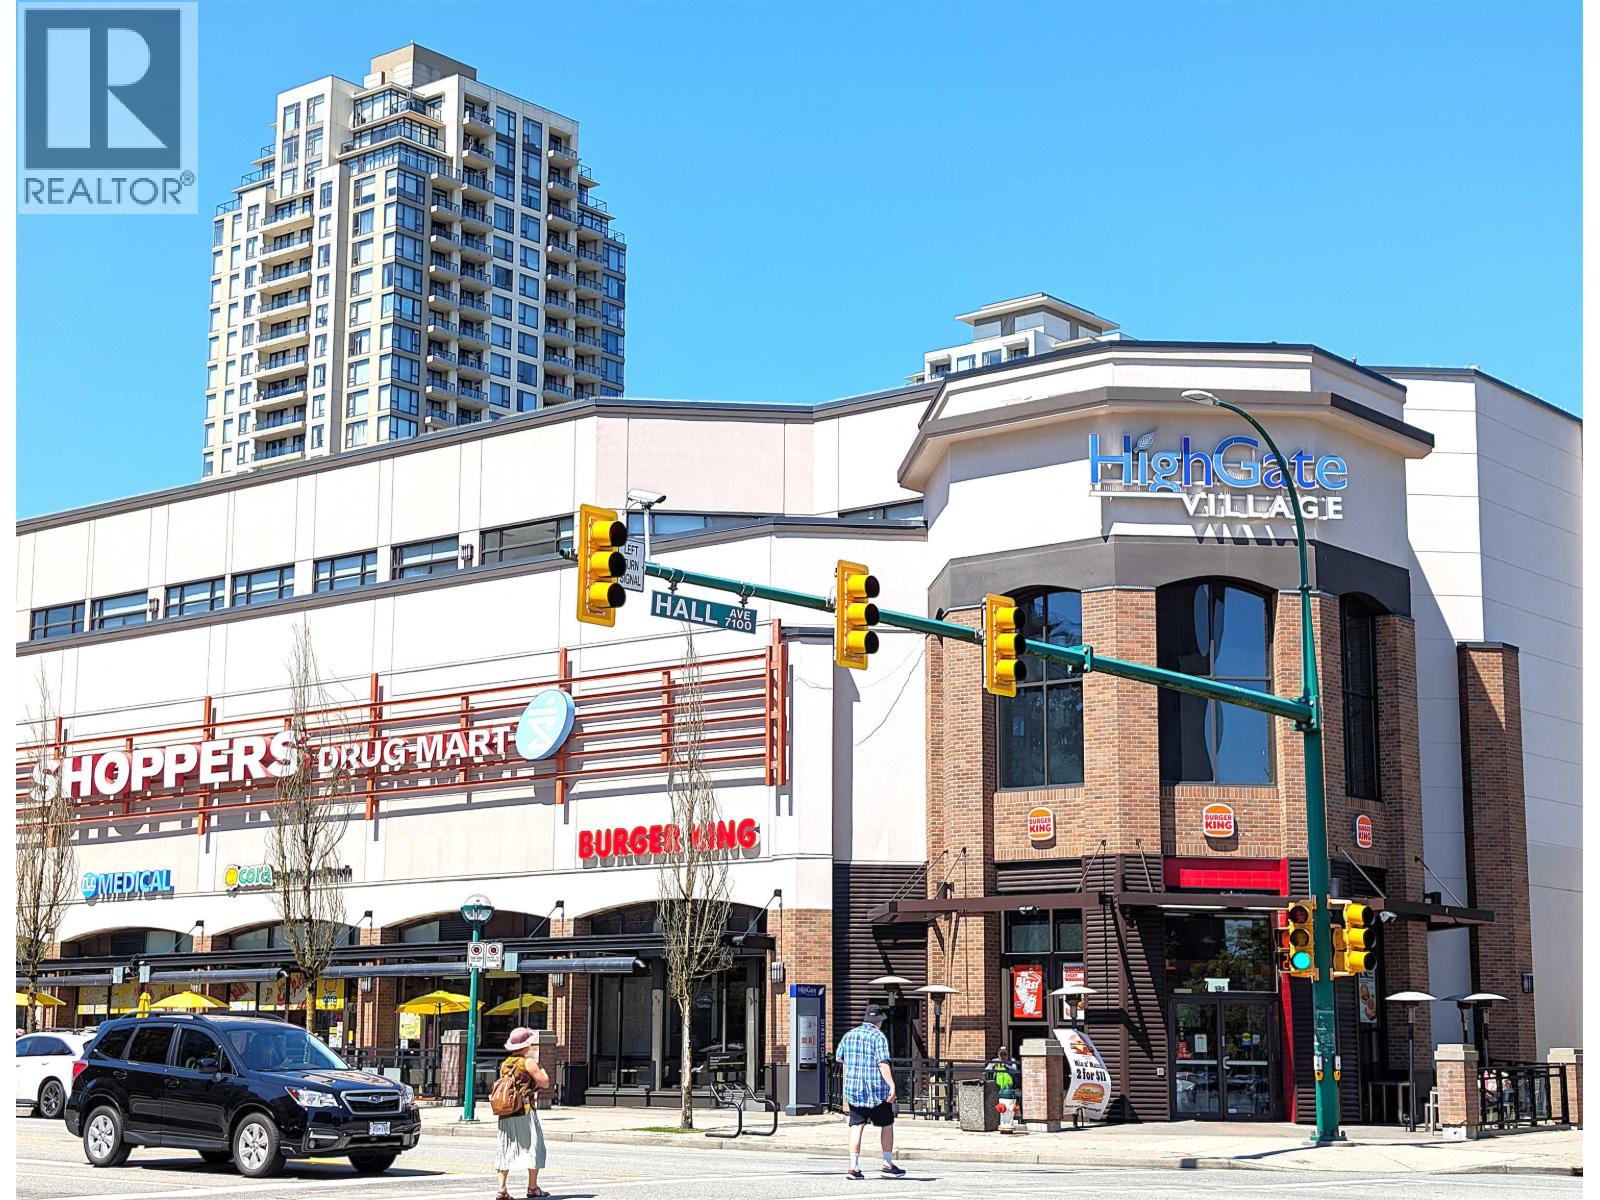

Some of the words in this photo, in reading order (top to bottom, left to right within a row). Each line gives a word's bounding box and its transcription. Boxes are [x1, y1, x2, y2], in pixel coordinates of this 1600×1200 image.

[1089, 432, 1348, 492] HighGate
[1181, 493, 1344, 520] VILLAGE
[624, 544, 639, 557] LEFT
[655, 593, 718, 626] HALL
[730, 608, 751, 621] AVE
[724, 617, 752, 631] 7100
[29, 731, 303, 801] SHOPPERS
[318, 738, 405, 773] DRUG
[416, 726, 511, 764] MART
[1029, 817, 1052, 825] BURGER
[1205, 821, 1233, 830] KING
[1029, 824, 1052, 833] KING
[579, 823, 680, 859] BURGER
[690, 818, 757, 853] KING
[98, 870, 172, 894] MEDICAL
[1077, 1069, 1082, 1079] 2
[1083, 1068, 1095, 1080] for
[1096, 1070, 1107, 1082] $11
